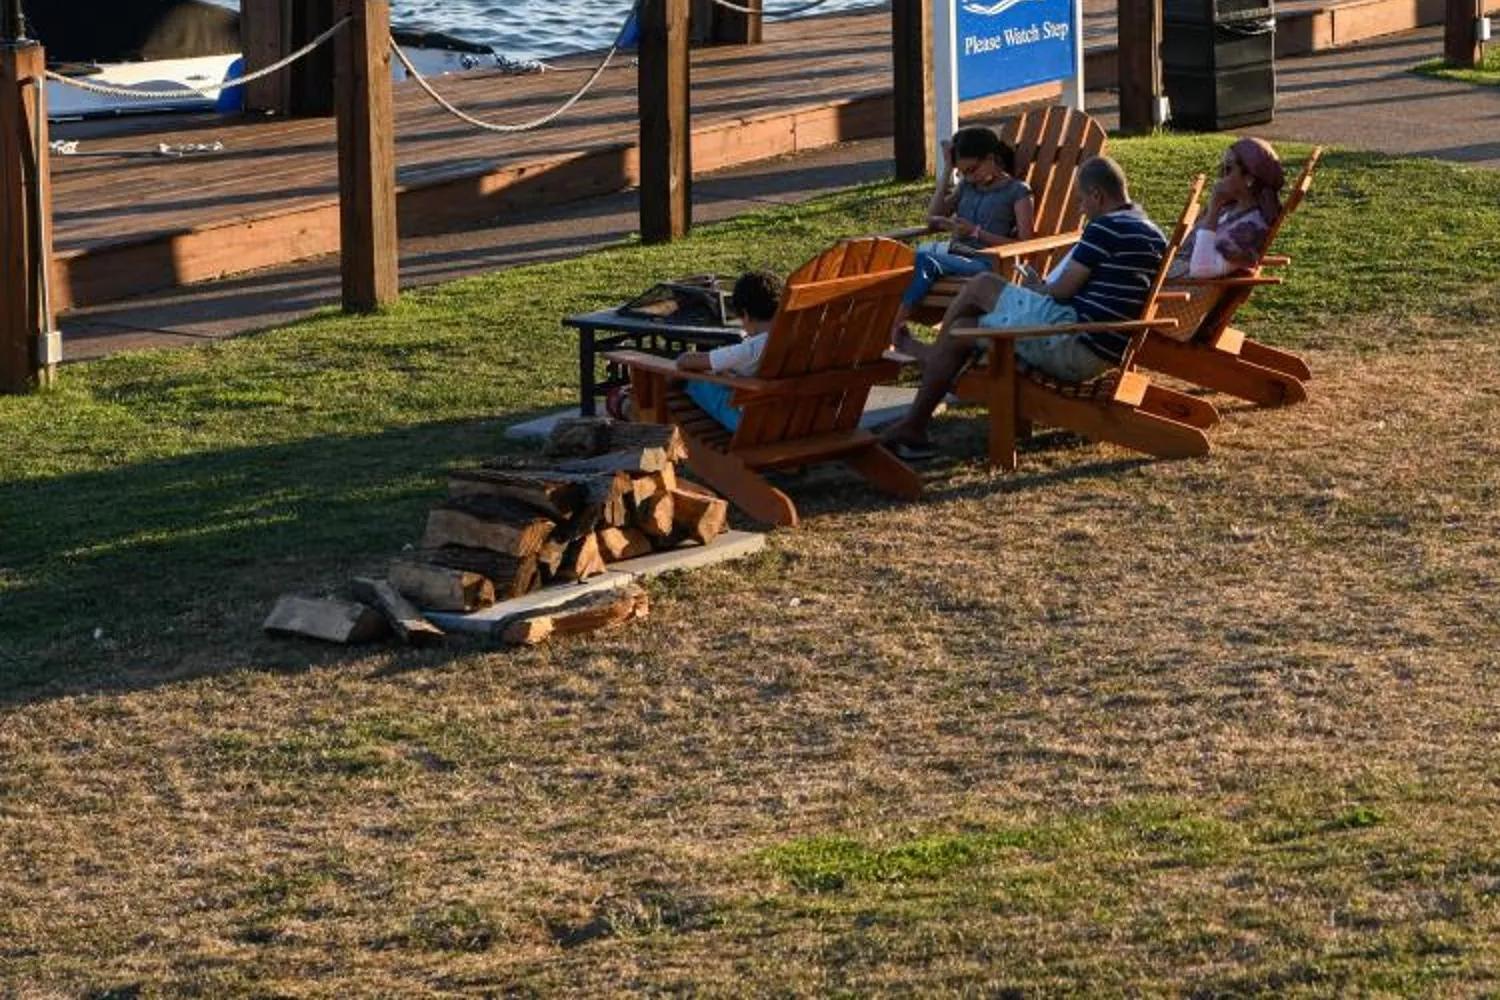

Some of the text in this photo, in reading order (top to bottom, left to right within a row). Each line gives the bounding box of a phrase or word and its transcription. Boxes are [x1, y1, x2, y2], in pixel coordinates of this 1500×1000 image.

[965, 21, 1069, 55] Please Watch Step
